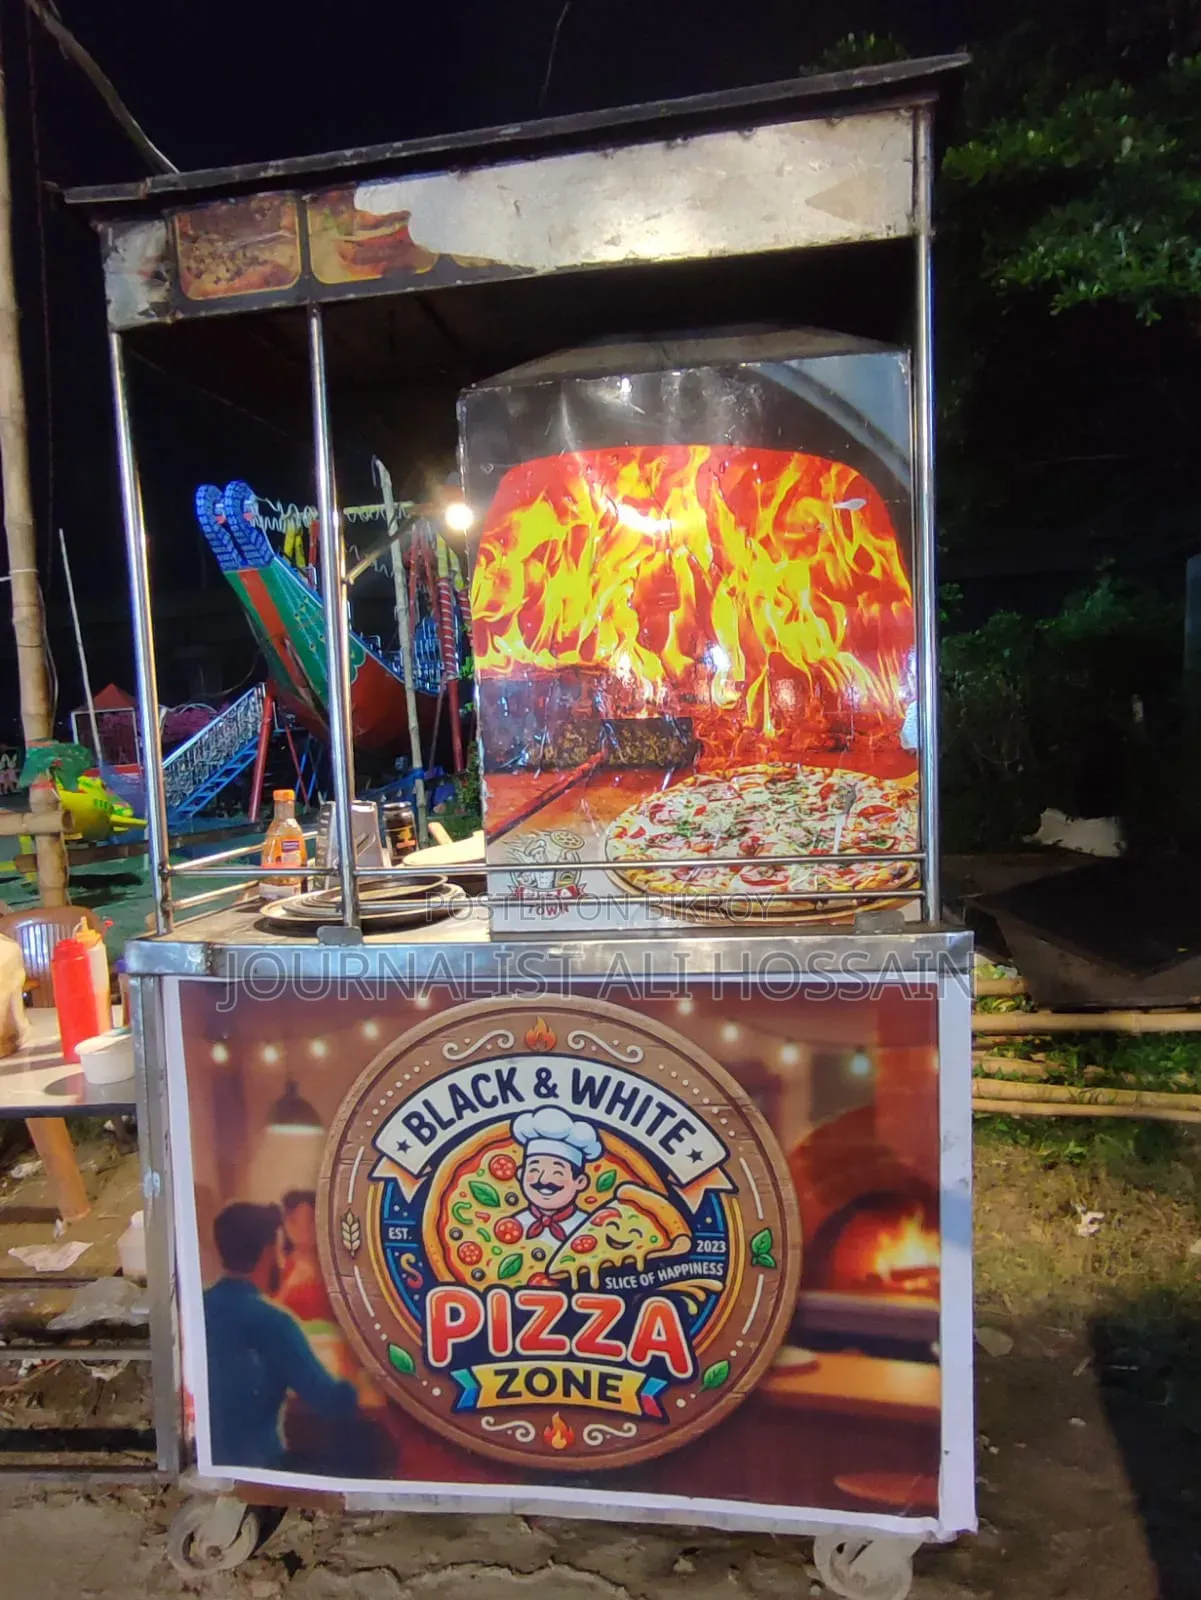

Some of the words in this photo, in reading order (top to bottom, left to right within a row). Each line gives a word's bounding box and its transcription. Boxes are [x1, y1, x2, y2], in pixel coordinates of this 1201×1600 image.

[401, 1066, 526, 1146] BLACK
[533, 1067, 560, 1099] &
[571, 1067, 698, 1156] WHITE
[388, 1227, 412, 1240] EST.
[696, 1240, 727, 1253] 2023
[604, 1276, 638, 1289] SLICE
[640, 1272, 656, 1286] OF
[657, 1261, 724, 1281] HAPPINESS
[426, 1287, 693, 1378] PIZZA
[493, 1367, 625, 1405] ZONE
